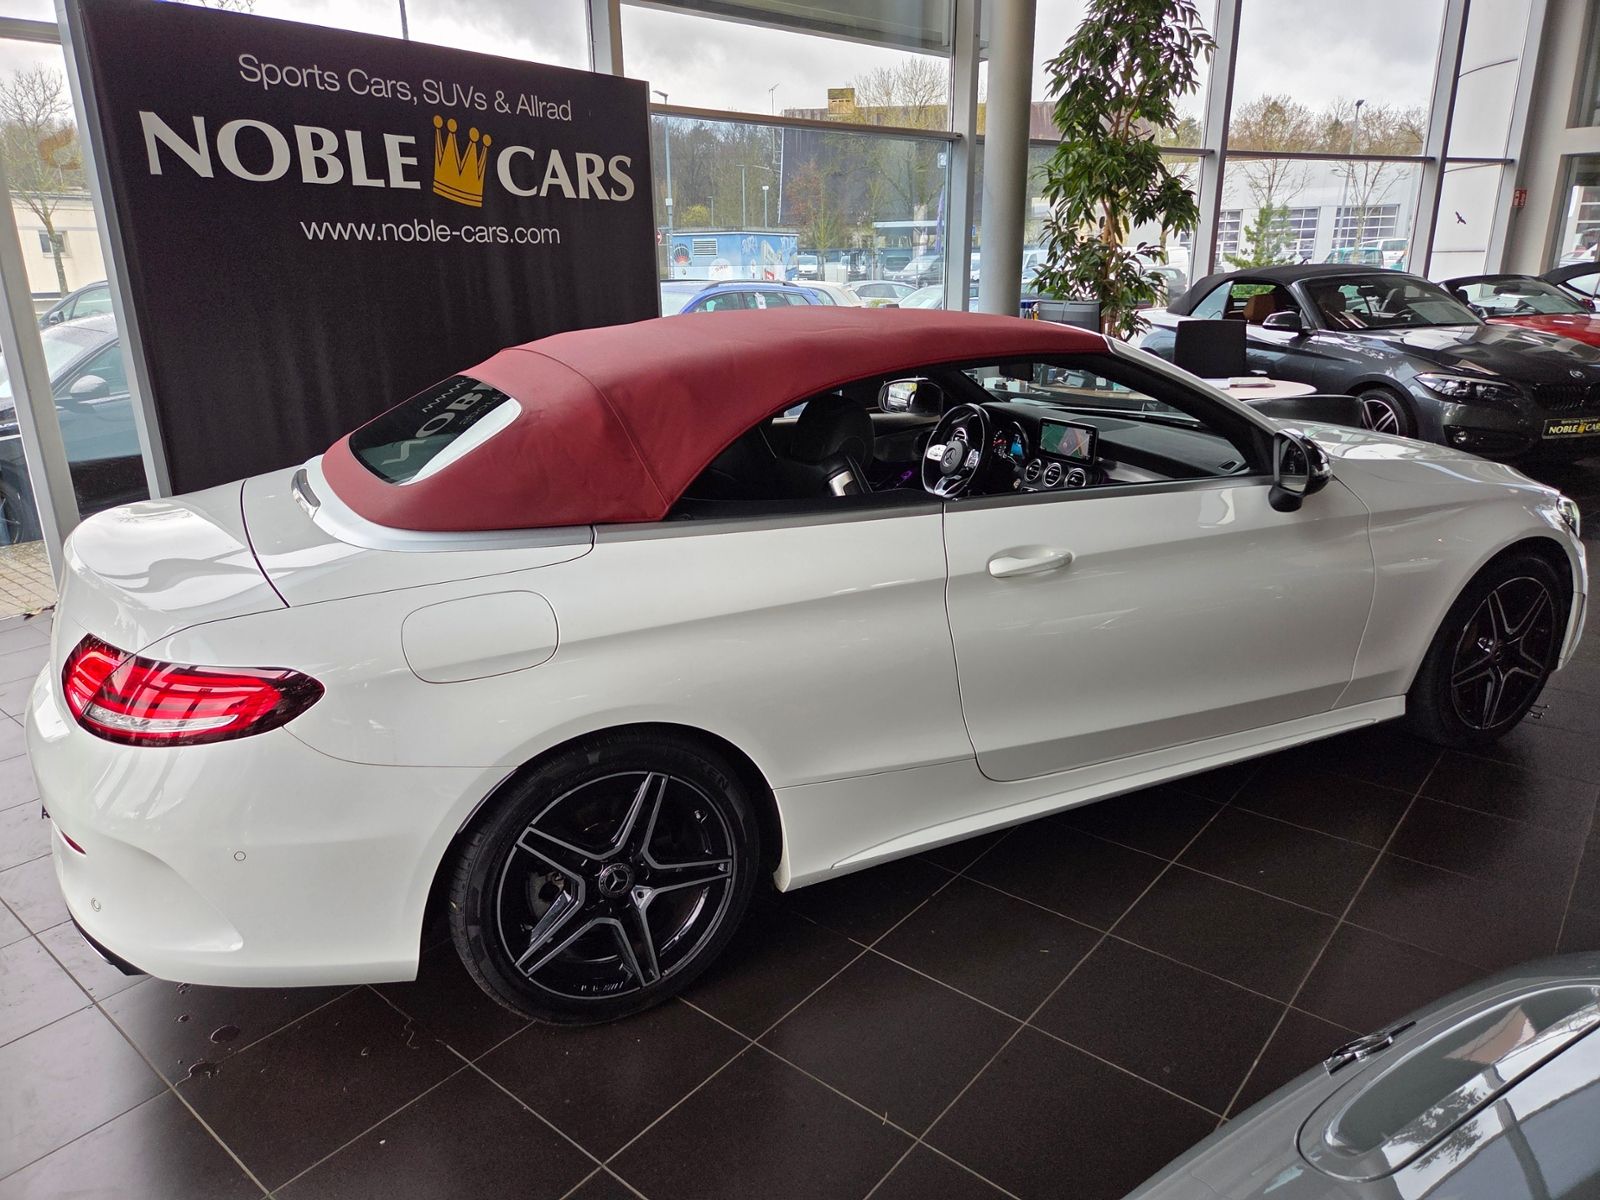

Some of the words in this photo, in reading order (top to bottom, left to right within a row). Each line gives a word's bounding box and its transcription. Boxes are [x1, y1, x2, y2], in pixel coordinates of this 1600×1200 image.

[238, 53, 341, 92] Sports
[347, 68, 418, 106] Cars,
[423, 78, 488, 112] SUVs
[494, 90, 512, 114] &
[516, 94, 573, 121] Allrad
[138, 110, 421, 190] NOBLE
[496, 145, 635, 202] CARS
[299, 218, 561, 244] www.noble-cars.com
[1548, 425, 1579, 434] NOBLE
